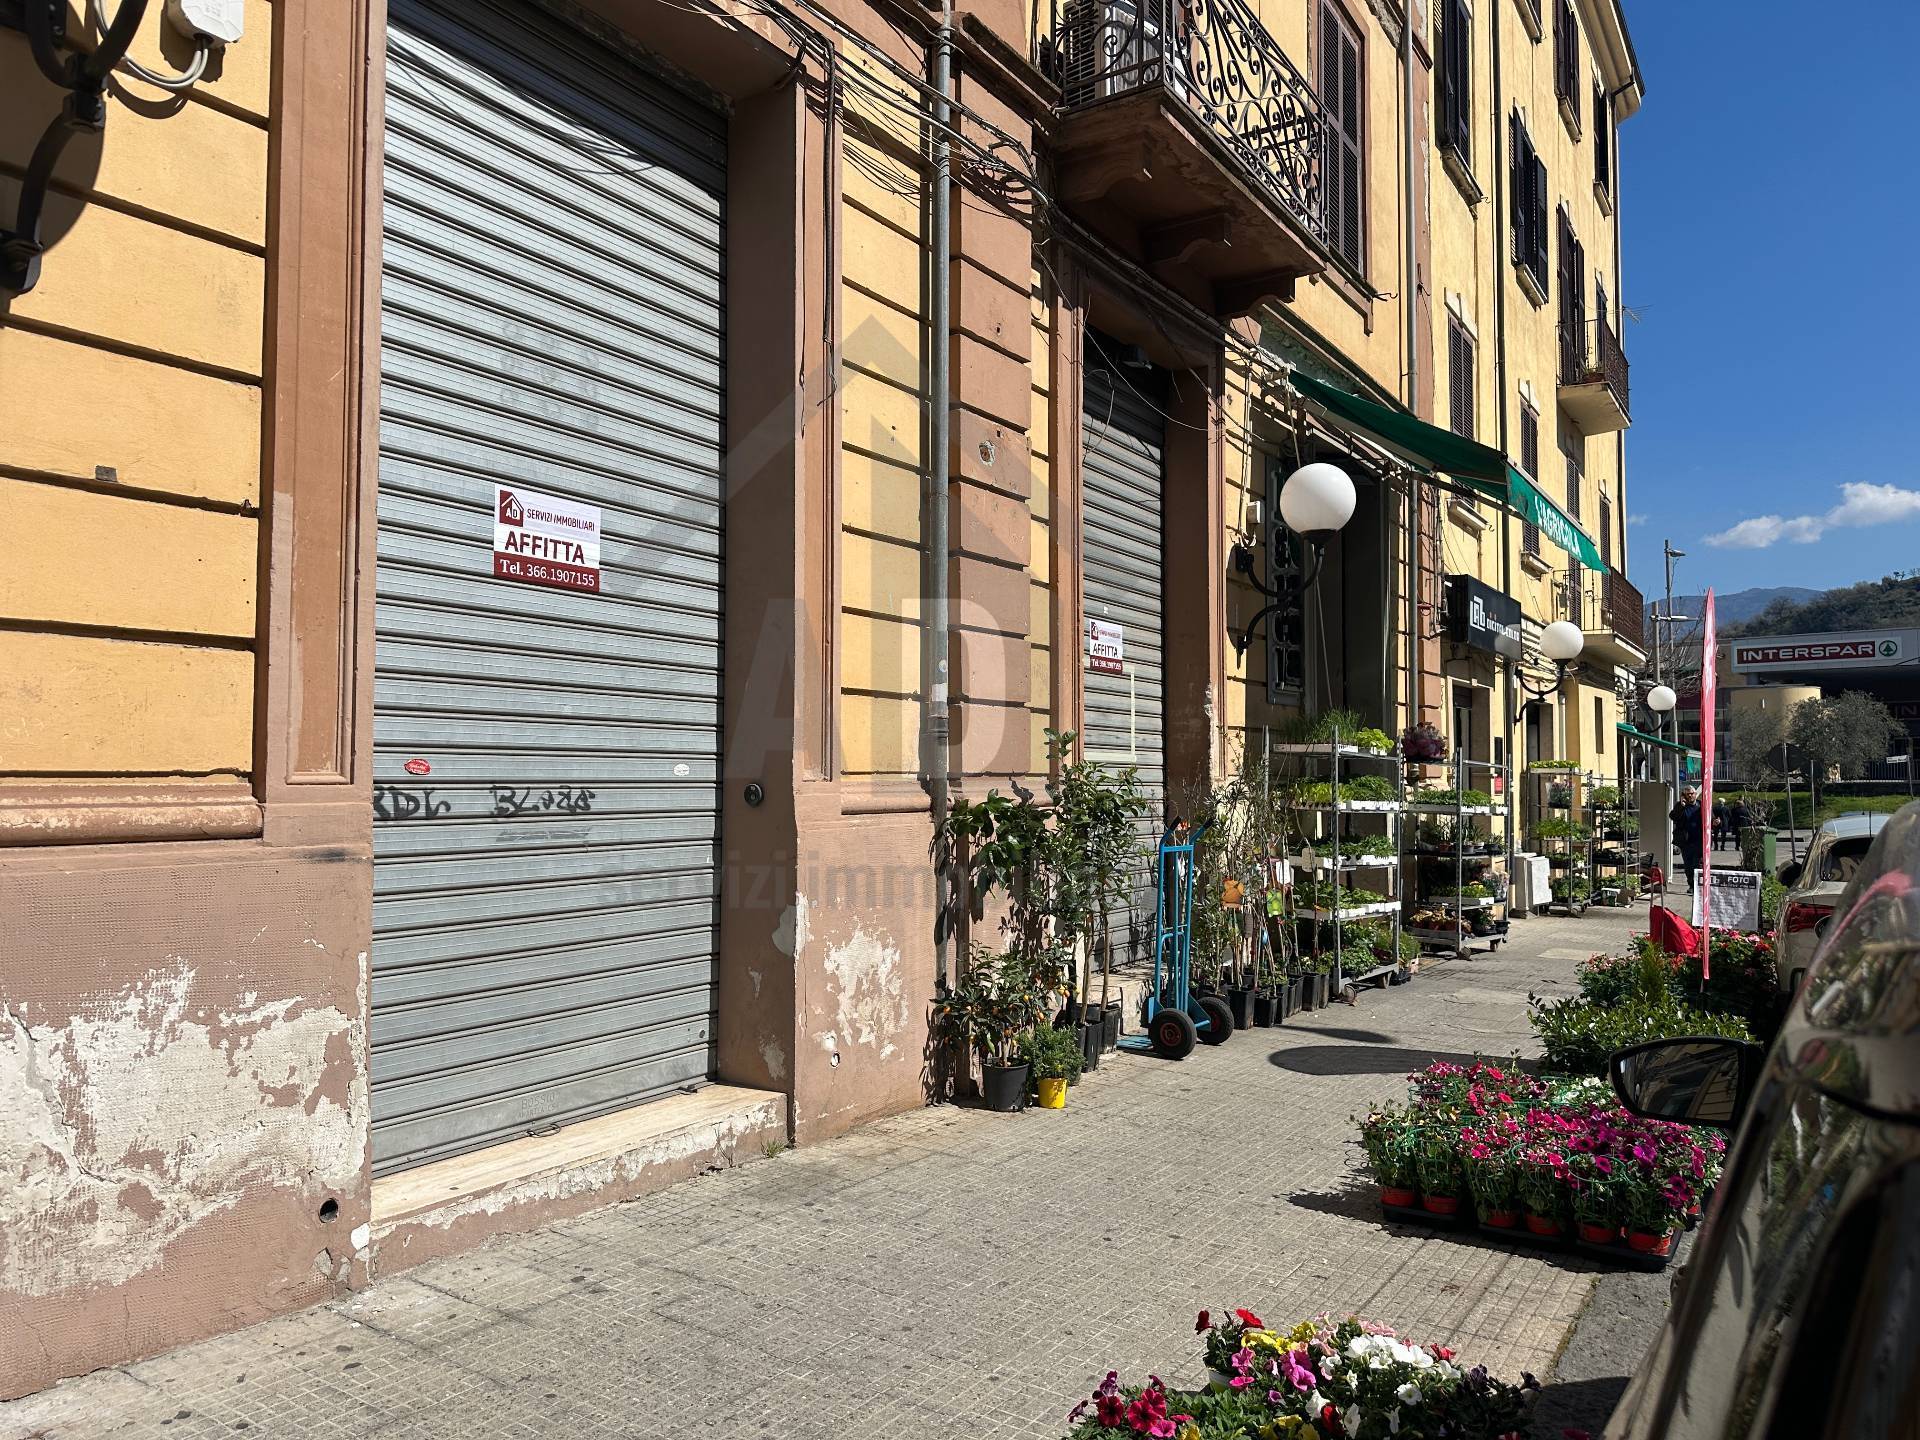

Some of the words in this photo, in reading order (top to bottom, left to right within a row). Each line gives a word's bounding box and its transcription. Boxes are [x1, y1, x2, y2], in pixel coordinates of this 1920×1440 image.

[527, 508, 553, 522] SERVIZI
[554, 514, 595, 532] IMMOBILIARI
[504, 530, 585, 564] AFFITTA
[500, 559, 524, 576] Tel.
[526, 564, 595, 587] 366.1907155
[1093, 643, 1119, 658] AFFITTA
[1743, 643, 1873, 661] INTERSPAR
[1727, 875, 1750, 884] FOTO
